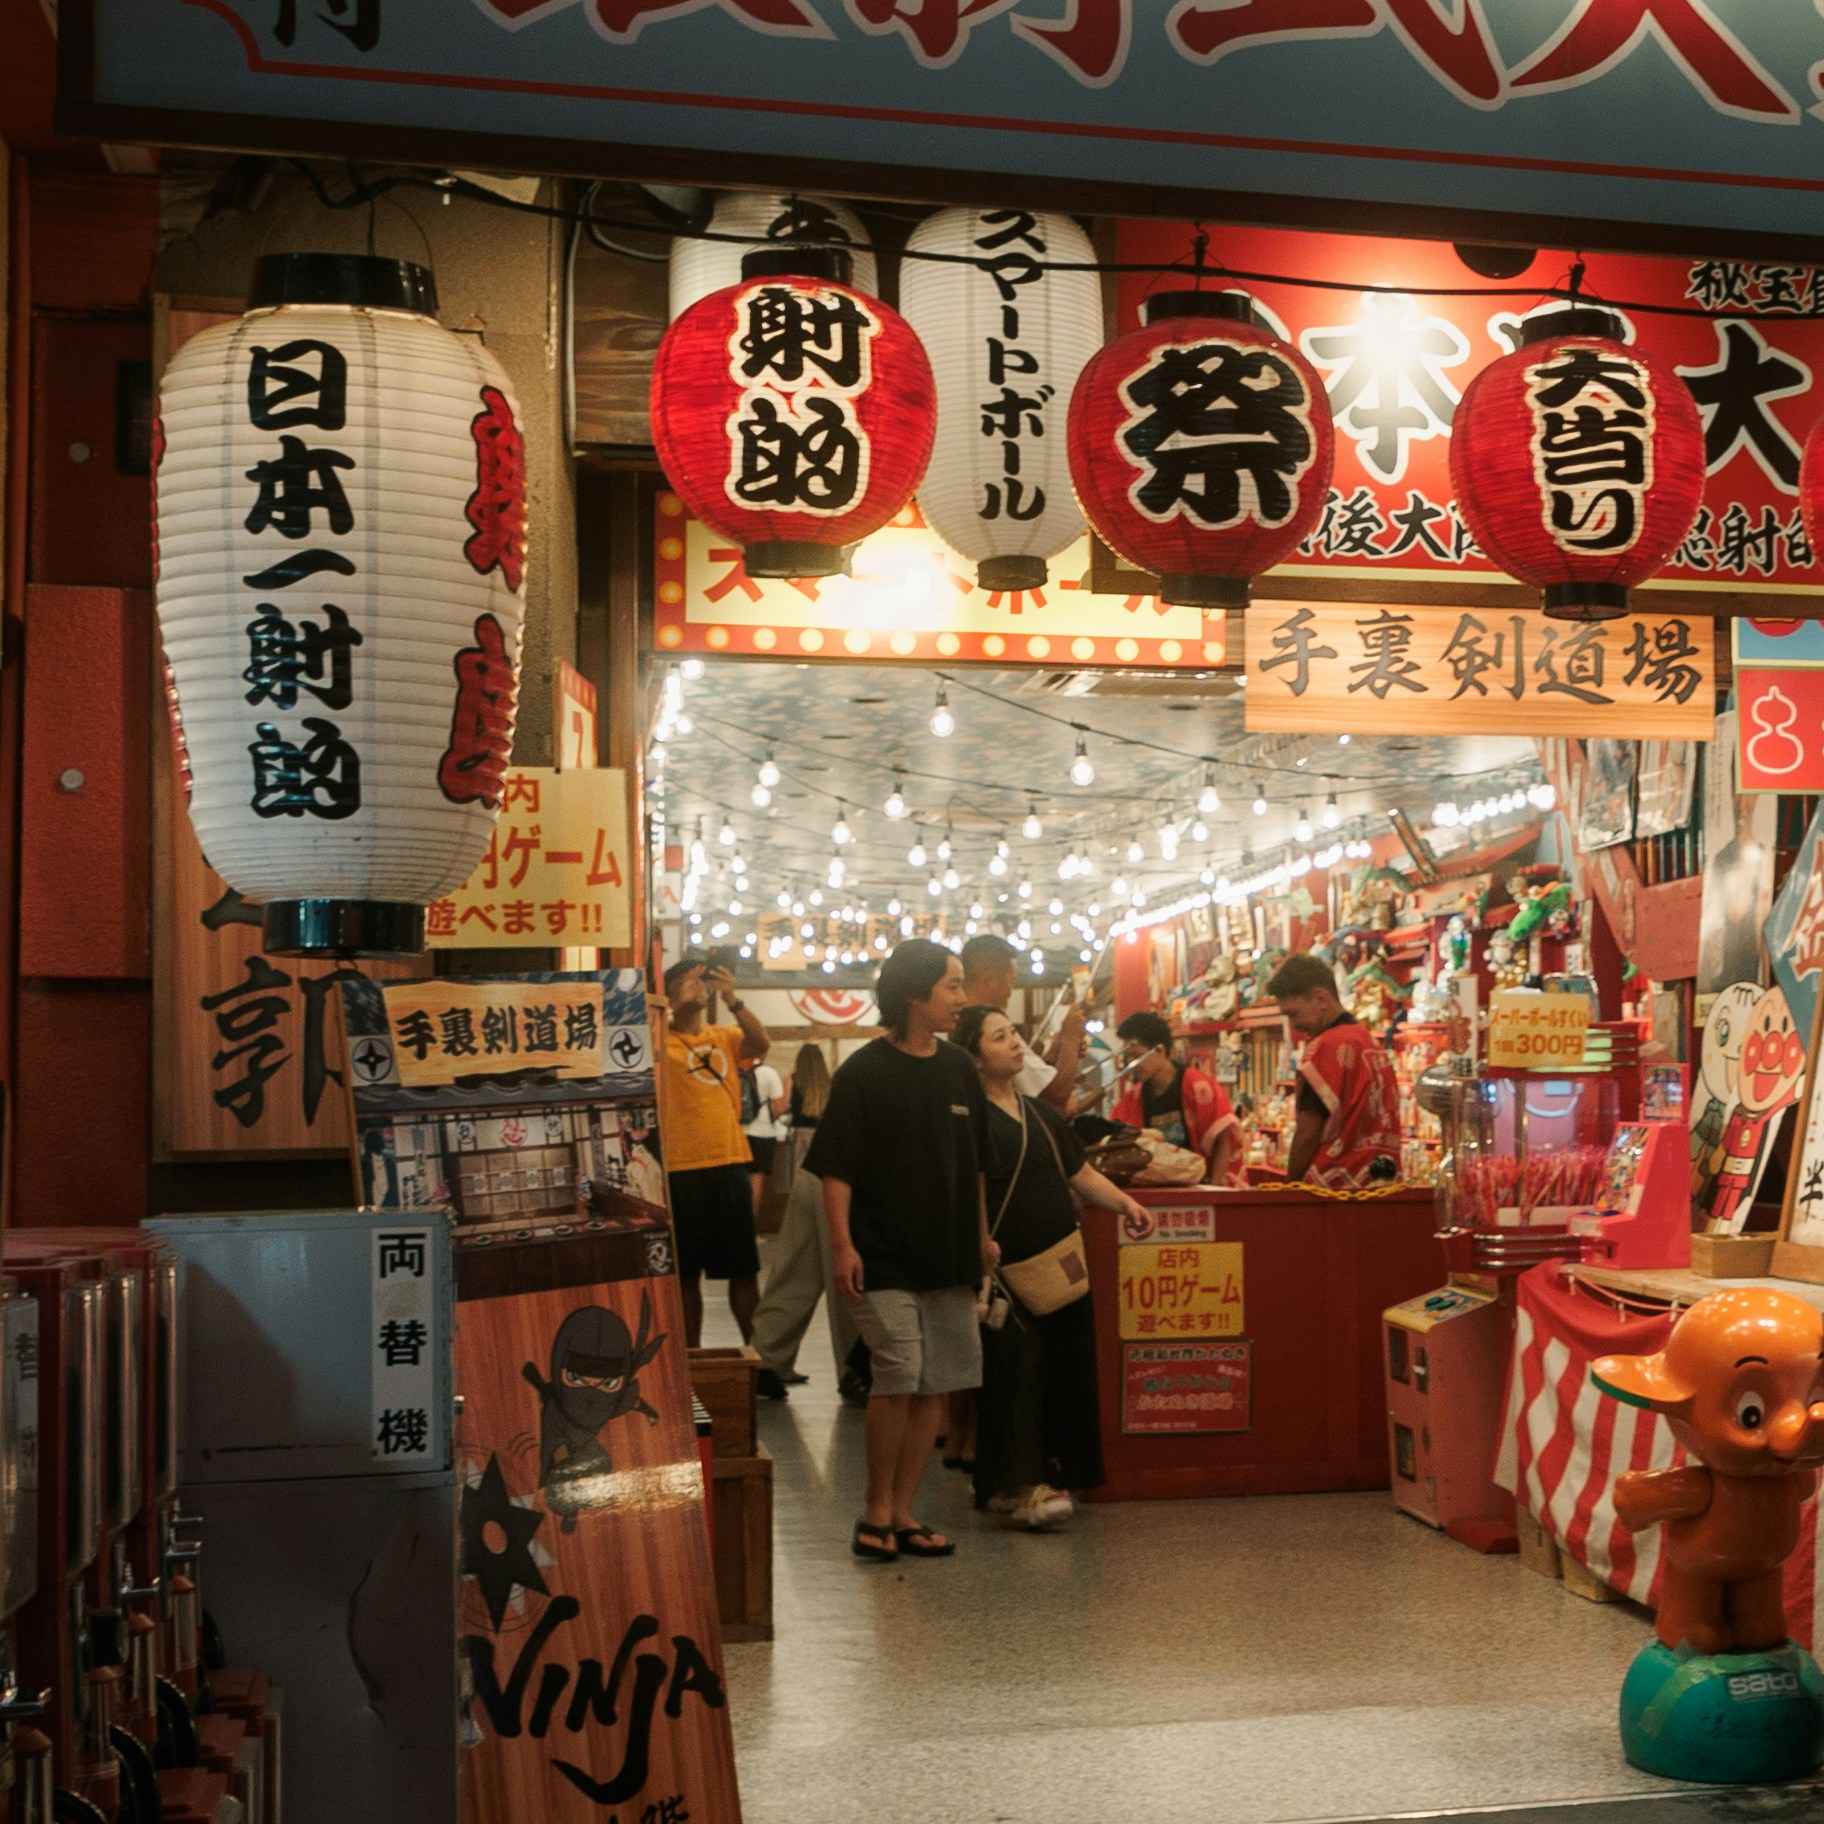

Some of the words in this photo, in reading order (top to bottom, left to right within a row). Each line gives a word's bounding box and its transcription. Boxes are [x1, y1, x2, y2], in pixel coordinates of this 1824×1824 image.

[979, 209, 1055, 521] スマートボール
[1124, 344, 1309, 524] 祭
[1534, 349, 1646, 549] 大当り
[1259, 608, 1703, 705] 手裏剣道場
[396, 1002, 602, 1059] 手裏剣道場
[1122, 1273, 1241, 1309] 10円ゲーム
[1157, 1248, 1200, 1269] 店内
[376, 1232, 429, 1454] 両替機
